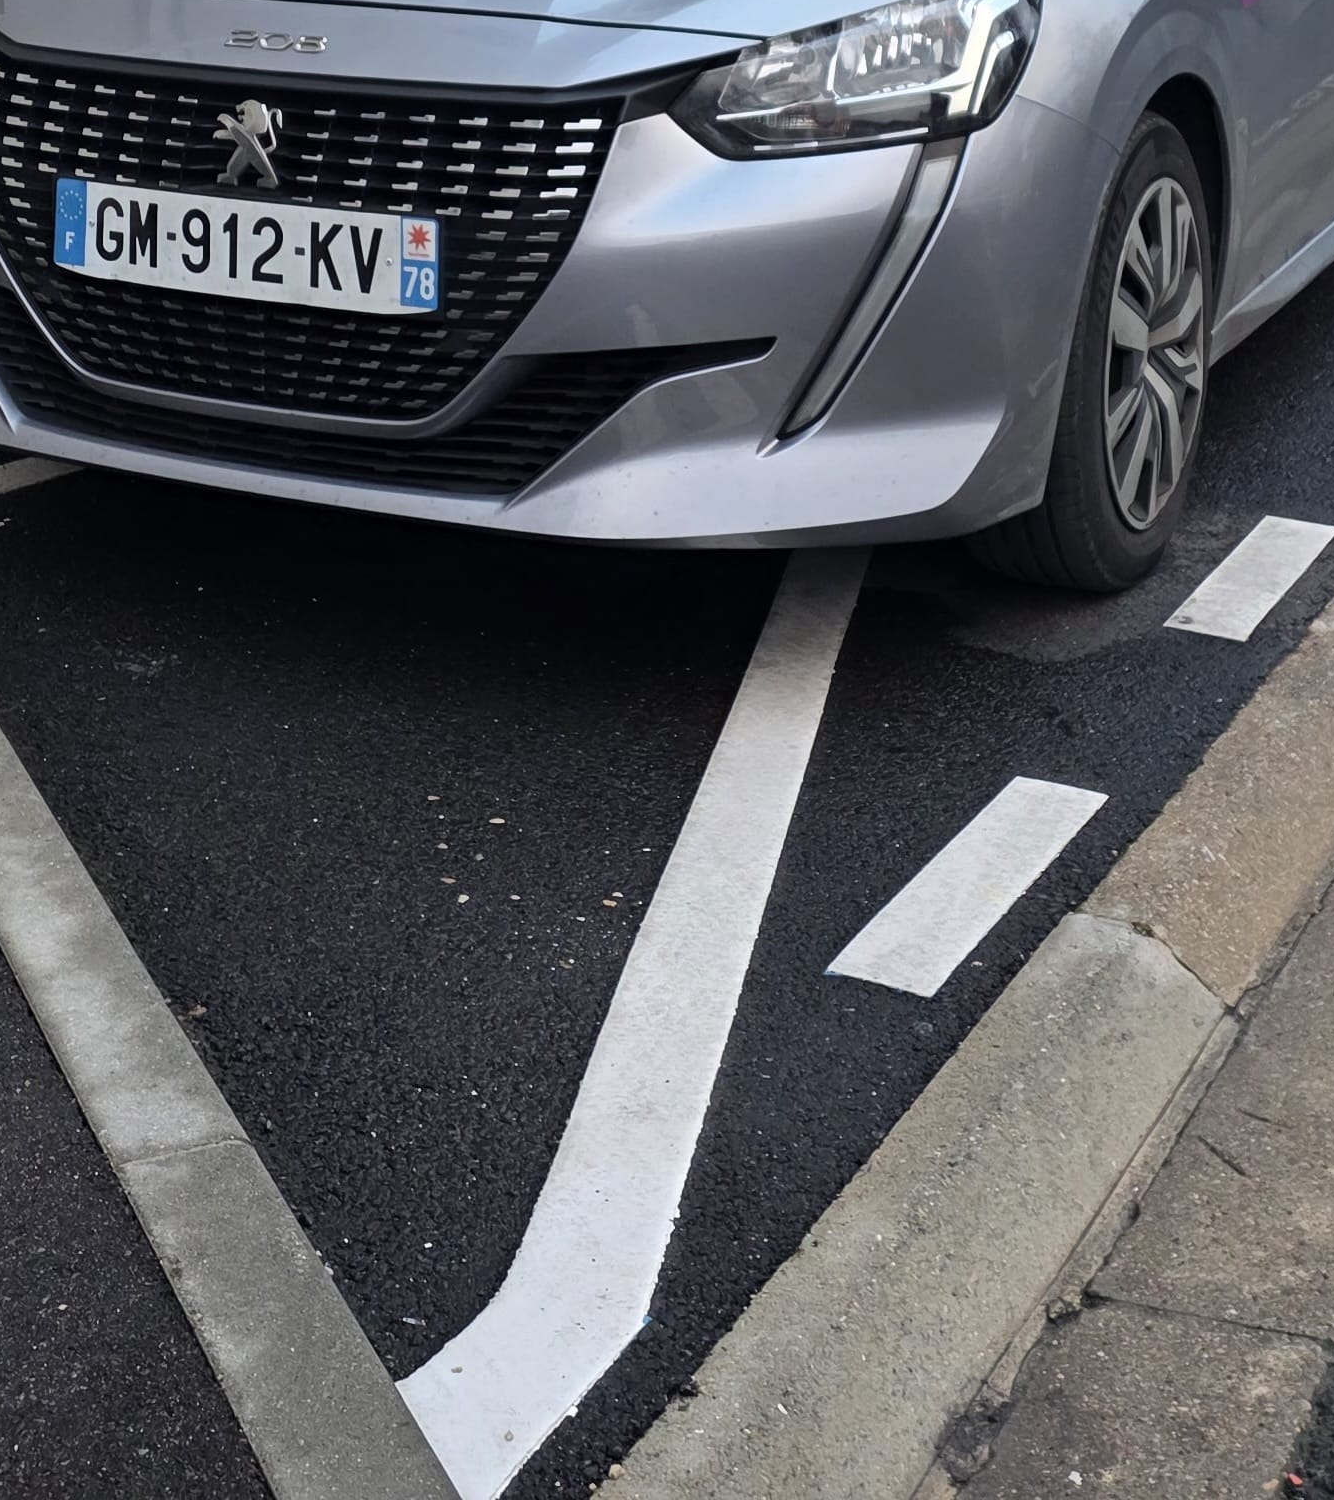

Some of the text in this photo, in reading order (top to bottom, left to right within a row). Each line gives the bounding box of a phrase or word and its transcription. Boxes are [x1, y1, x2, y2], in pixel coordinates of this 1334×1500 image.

[224, 29, 328, 53] 208
[65, 232, 75, 250] F
[95, 197, 383, 294] GM-912-KV
[404, 266, 435, 300] 78
